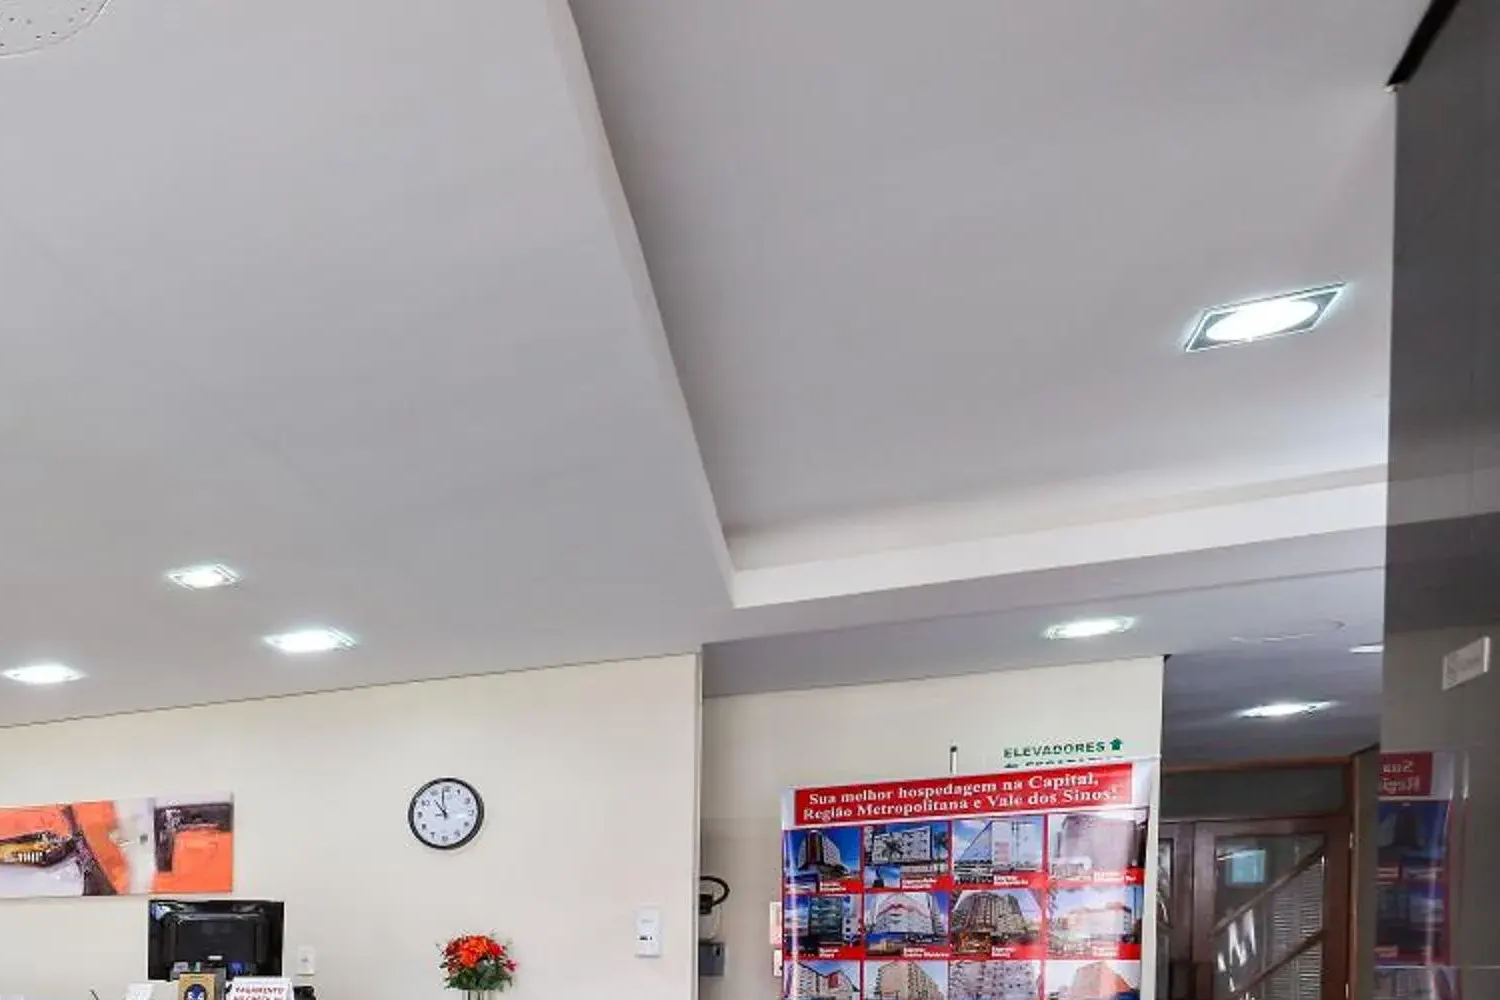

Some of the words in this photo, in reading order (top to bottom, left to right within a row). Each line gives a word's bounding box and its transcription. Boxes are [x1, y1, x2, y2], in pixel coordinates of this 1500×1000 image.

[1003, 741, 1105, 759] ELEVADORES
[802, 805, 852, 824] Região
[856, 798, 969, 818] Metropolitana
[973, 799, 982, 808] e
[987, 794, 1023, 808] Vale
[1028, 791, 1057, 806] dos
[1062, 786, 1119, 802] Sinos!
[808, 792, 837, 806] Sua
[840, 788, 893, 804] melhor
[898, 780, 997, 800] hospedagem
[1003, 778, 1023, 791] na
